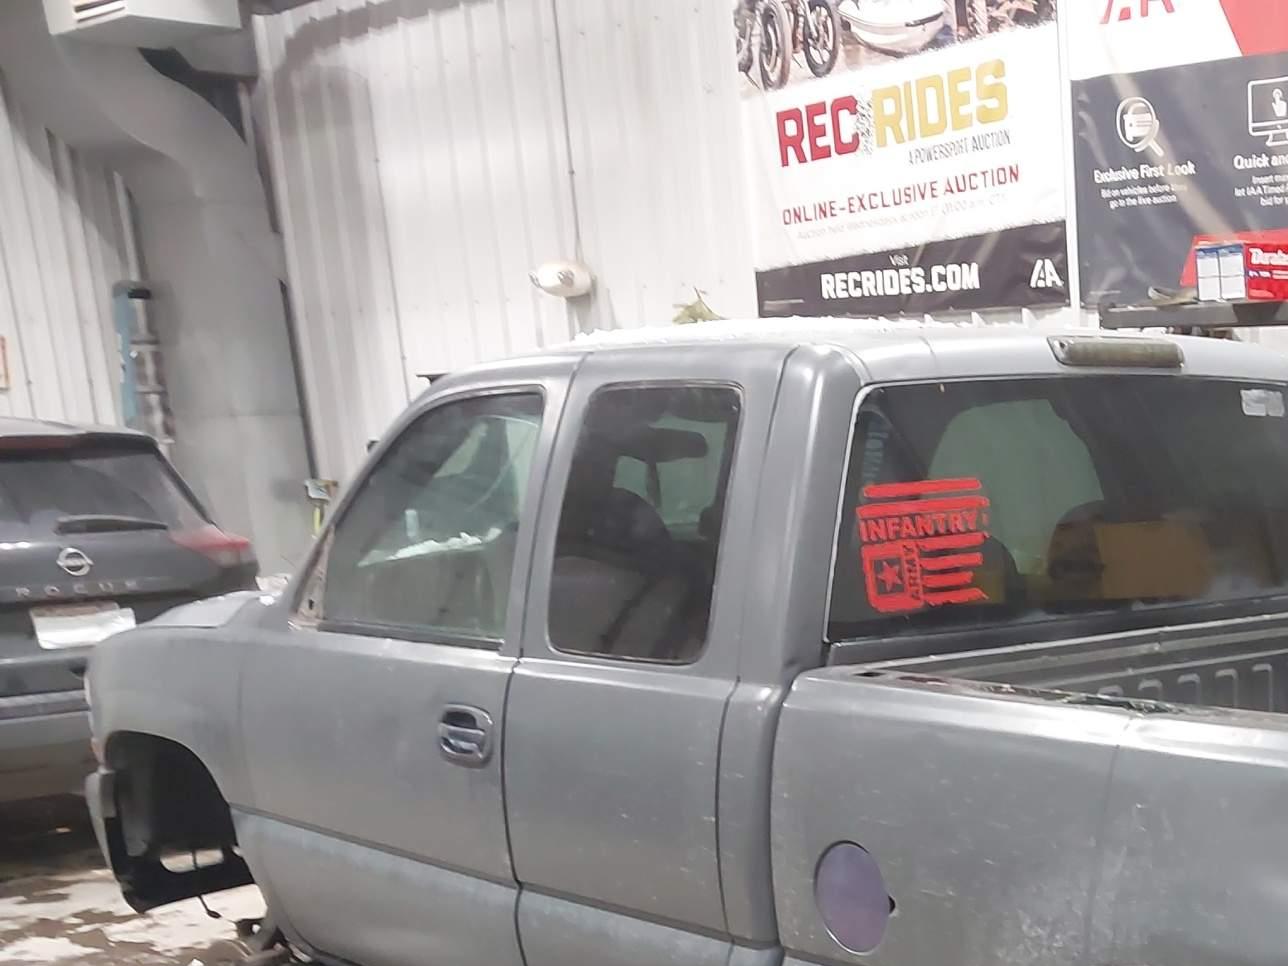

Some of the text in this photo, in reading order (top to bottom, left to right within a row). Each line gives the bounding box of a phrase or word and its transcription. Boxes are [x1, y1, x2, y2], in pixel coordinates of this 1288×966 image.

[872, 59, 1008, 148] RIDES
[776, 95, 861, 167] REC
[972, 130, 1012, 153] AUCTION
[1094, 160, 1196, 183] Exclusive First Look
[1233, 153, 1270, 169] Quick
[783, 179, 939, 226] ONLINE-EXCLUSIVE
[944, 164, 1020, 195] AUCTION
[821, 262, 980, 300] RECRIDES.COM
[860, 509, 977, 542] INFANTRY
